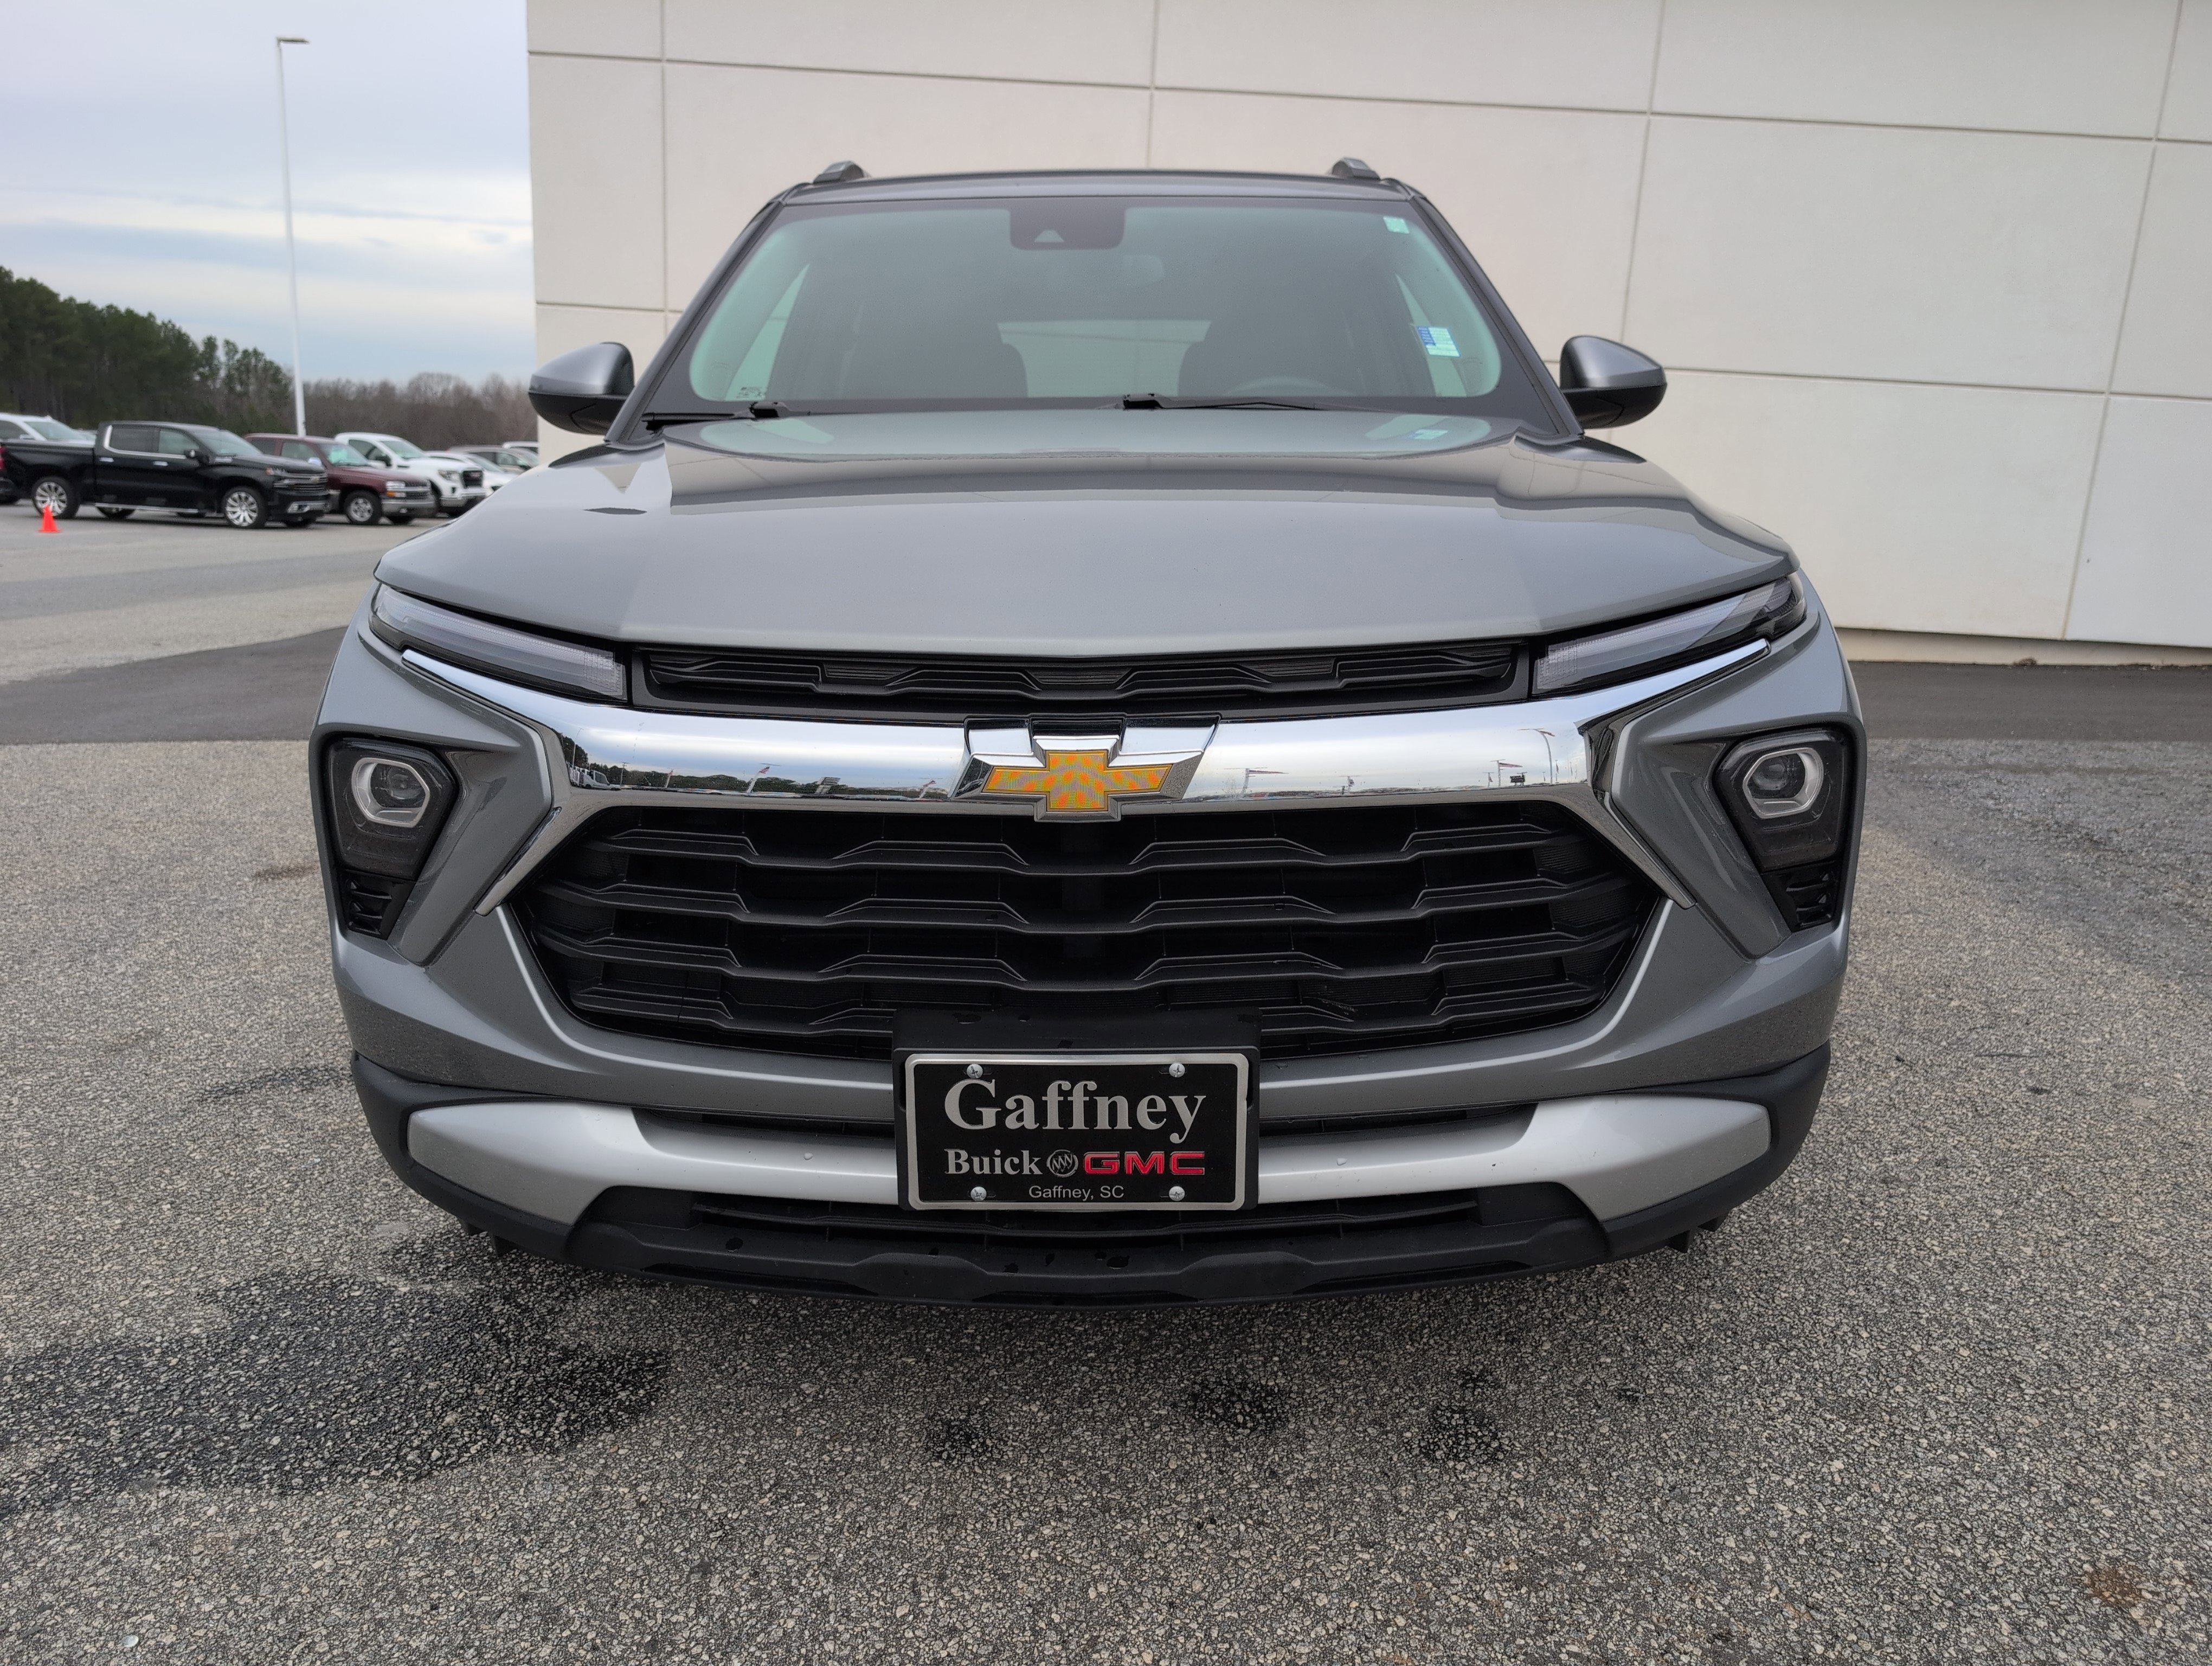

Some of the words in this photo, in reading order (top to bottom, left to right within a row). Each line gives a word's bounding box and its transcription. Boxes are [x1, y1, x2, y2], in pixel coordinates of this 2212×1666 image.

[944, 1078, 1206, 1144] Gaffney
[944, 1149, 1043, 1175] Buick
[1083, 1151, 1205, 1175] GMC
[1028, 1185, 1095, 1201] Gaffney,
[1099, 1186, 1124, 1199] SC
